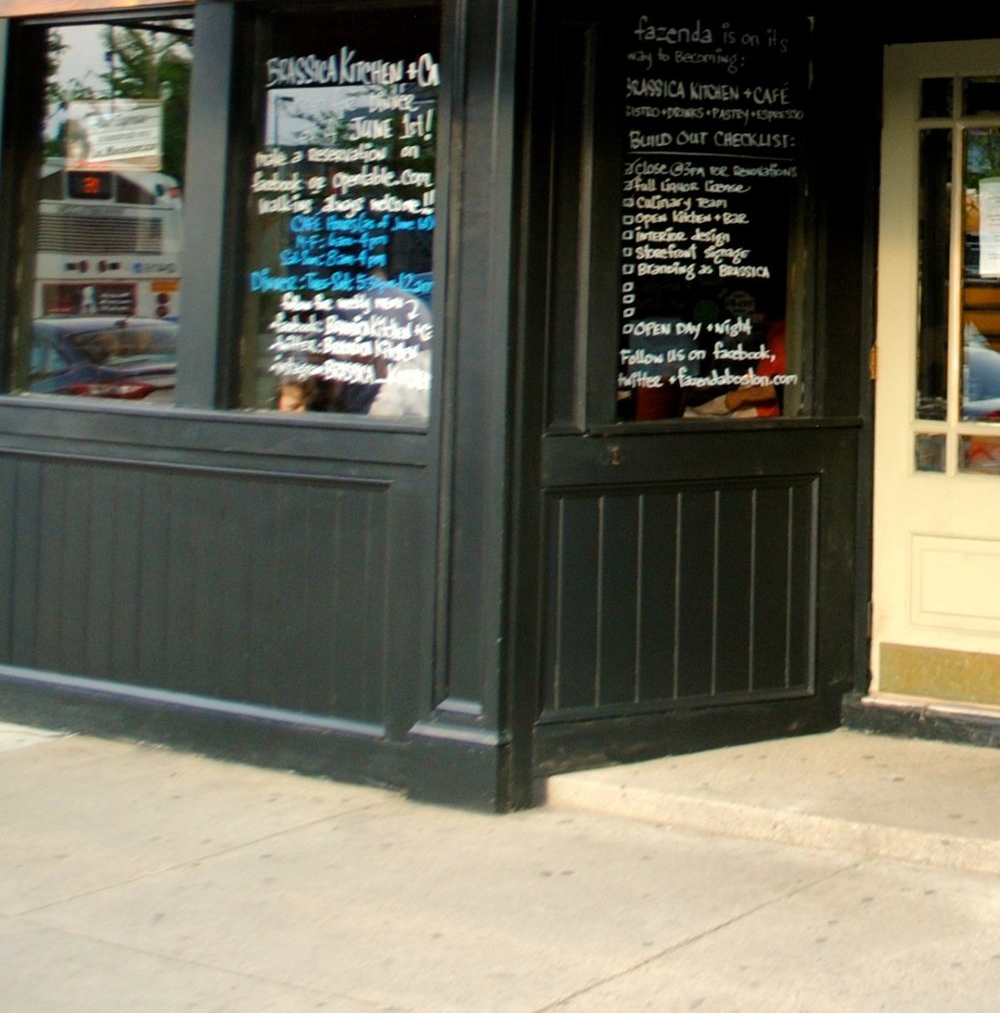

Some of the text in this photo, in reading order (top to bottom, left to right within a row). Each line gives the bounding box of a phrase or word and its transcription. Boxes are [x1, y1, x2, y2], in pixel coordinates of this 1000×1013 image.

[634, 15, 713, 44] fazenda
[690, 82, 740, 101] KITCHEN
[676, 131, 709, 146] OUT
[688, 349, 706, 360] on
